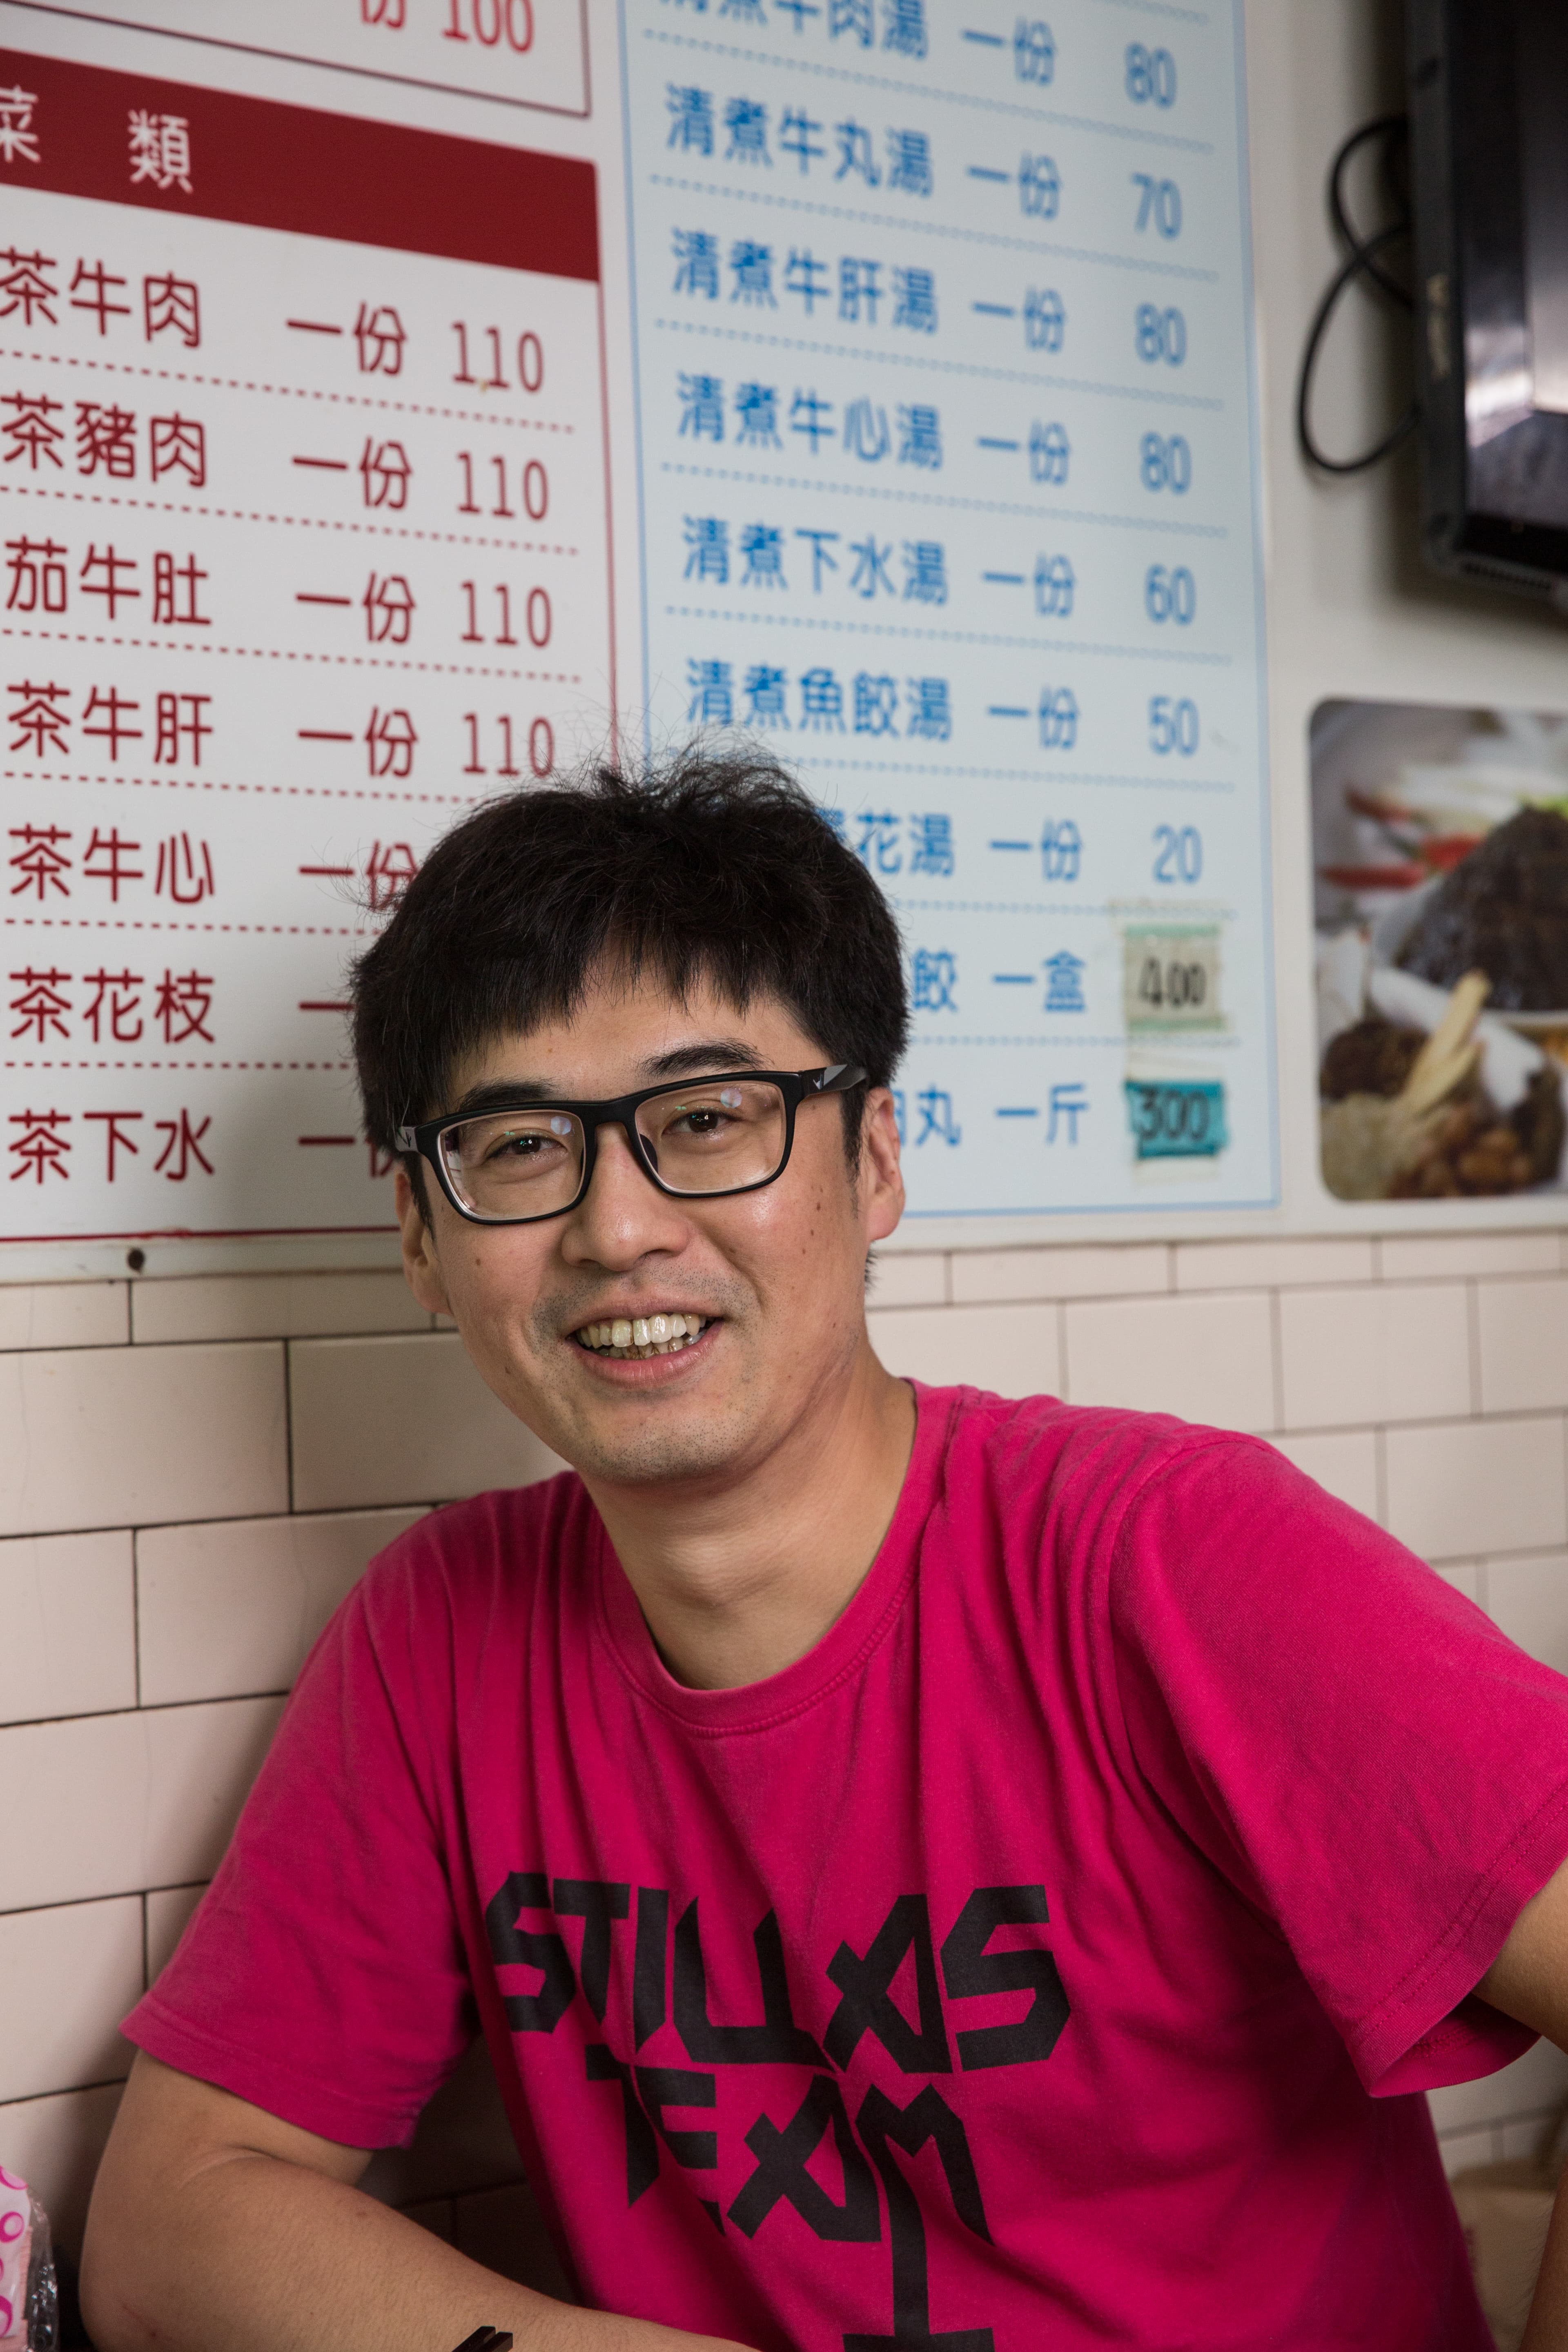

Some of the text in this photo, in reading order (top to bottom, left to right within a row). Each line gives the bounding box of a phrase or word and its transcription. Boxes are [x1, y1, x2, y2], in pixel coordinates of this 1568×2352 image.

[443, 0, 533, 53] 100
[962, 22, 1055, 86] 一份
[1126, 43, 1175, 109] 80
[668, 86, 1181, 240] 清煮牛丸湯 一份 70
[0, 246, 543, 393] 茶牛肉 一份 110
[673, 229, 1185, 366] 清煮牛肝湯 一份 80
[0, 392, 548, 521] 茶豬肉 一份 110
[678, 374, 1190, 494] 清煮牛心湯 一份 80
[4, 535, 552, 648] 茄牛肚 一份 110
[684, 517, 1195, 625] 清煮下水湯 一份 60
[7, 679, 554, 779] 茶牛肝 一份 110
[688, 660, 1198, 757] 清煮魚餃湯 一份 50
[8, 823, 214, 904] 茶牛心
[816, 808, 1201, 884] 花湯 一份 20
[9, 967, 213, 1043] 茶花枝
[912, 949, 1085, 1013] 餃 一盒
[1139, 958, 1207, 1008] 400
[8, 1109, 212, 1185] 茶下水
[996, 1083, 1088, 1142] 一斤
[1135, 1084, 1209, 1141] 300
